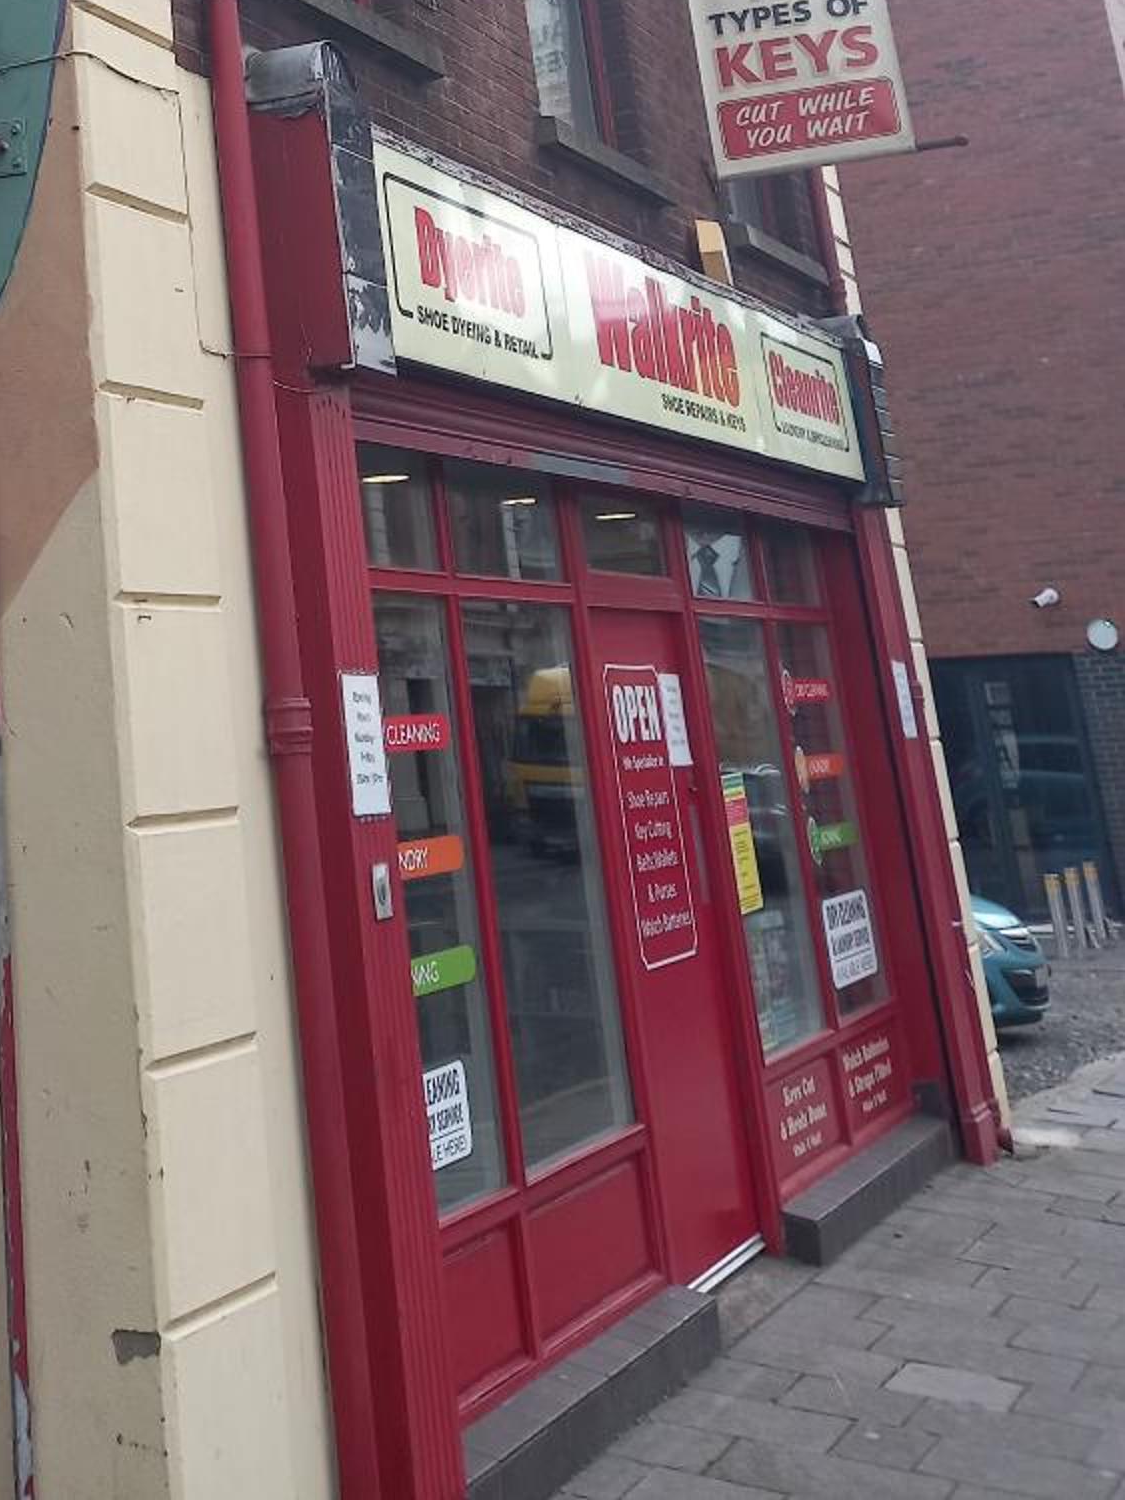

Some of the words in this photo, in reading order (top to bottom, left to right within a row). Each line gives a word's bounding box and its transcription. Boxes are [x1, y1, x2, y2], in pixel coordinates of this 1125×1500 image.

[709, 0, 812, 36] TYPES
[714, 25, 879, 88] KEYS
[736, 102, 781, 126] CUT
[798, 87, 874, 117] WHILE
[747, 123, 792, 149] YOU
[807, 112, 869, 139] WAIT
[414, 206, 527, 318] Dyerite
[417, 305, 450, 332] SHOE
[451, 315, 492, 346] DYEING
[504, 333, 539, 359] RETAIL
[586, 255, 741, 408] Walkrite
[387, 720, 440, 745] CLEANING
[613, 685, 662, 743] OPEN
